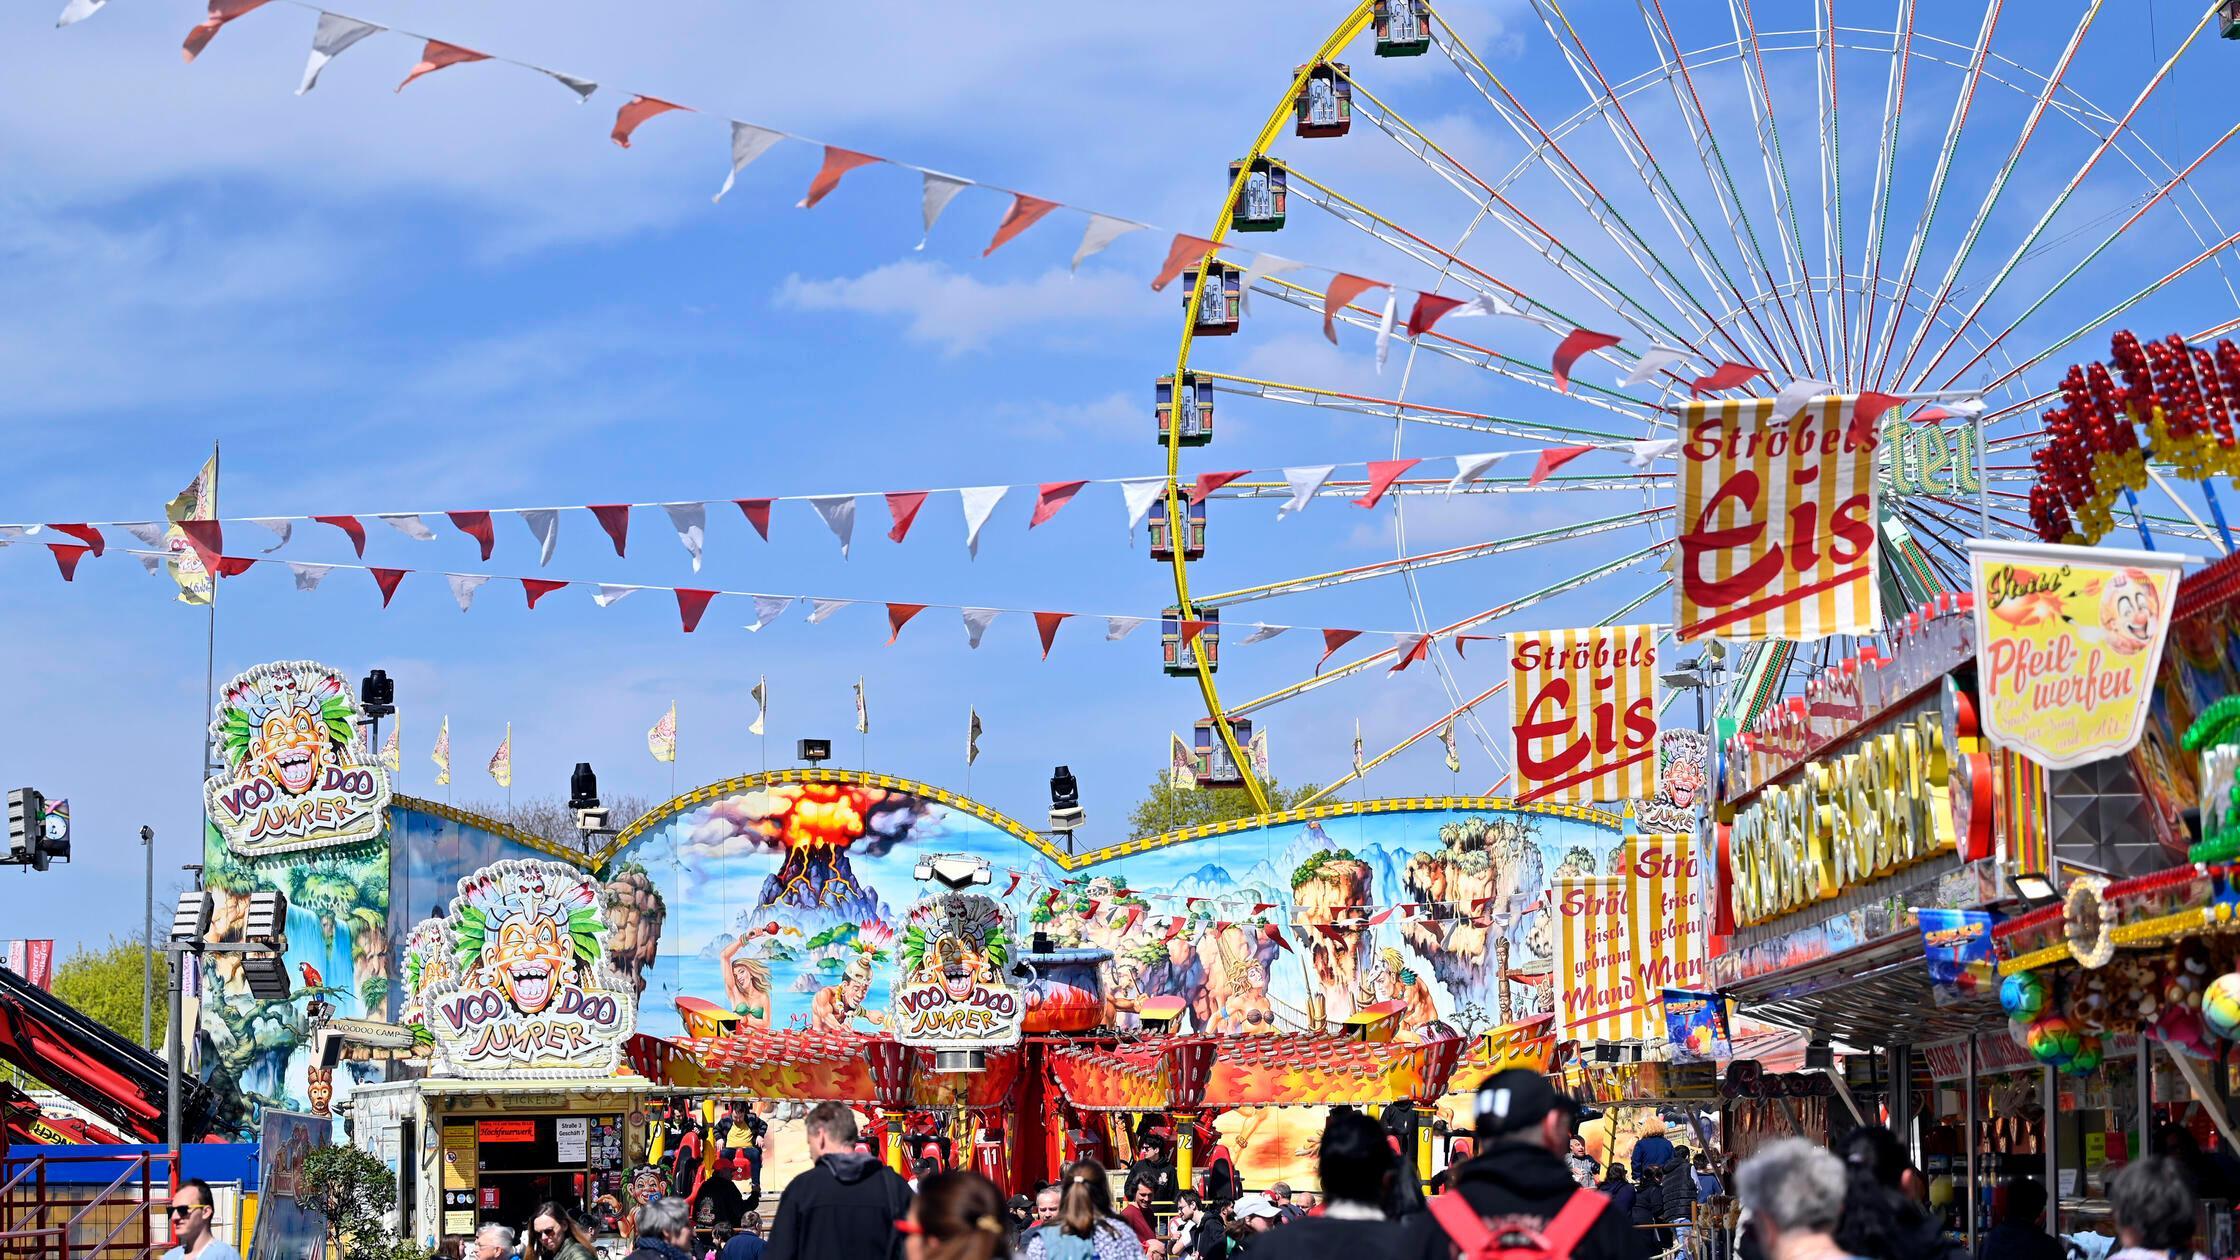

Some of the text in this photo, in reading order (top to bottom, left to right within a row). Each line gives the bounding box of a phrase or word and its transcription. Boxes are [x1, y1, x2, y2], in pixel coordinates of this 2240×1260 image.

[1682, 414, 1879, 462] Ströbels
[1678, 464, 1874, 608] Eis
[1511, 635, 1656, 672] Ströbels
[1987, 633, 2078, 697] Pfeil-
[2033, 648, 2132, 712] werfen
[1512, 674, 1657, 781] Eis
[220, 766, 374, 816] VOO DOO
[250, 794, 356, 838] JUMPER
[1660, 891, 1699, 917] frisc
[1584, 920, 1625, 950] frisch
[441, 986, 617, 1031] VOO DOO
[901, 985, 1014, 1014] VOO DOO
[337, 1023, 401, 1038] VOODOO CAMP
[468, 1020, 592, 1056] JUMPER
[911, 1008, 999, 1033] JUMPER
[506, 1095, 557, 1105] TICKETS
[1178, 1135, 1193, 1150] 12
[1422, 1127, 1430, 1143] 1
[982, 1148, 997, 1166] 11
